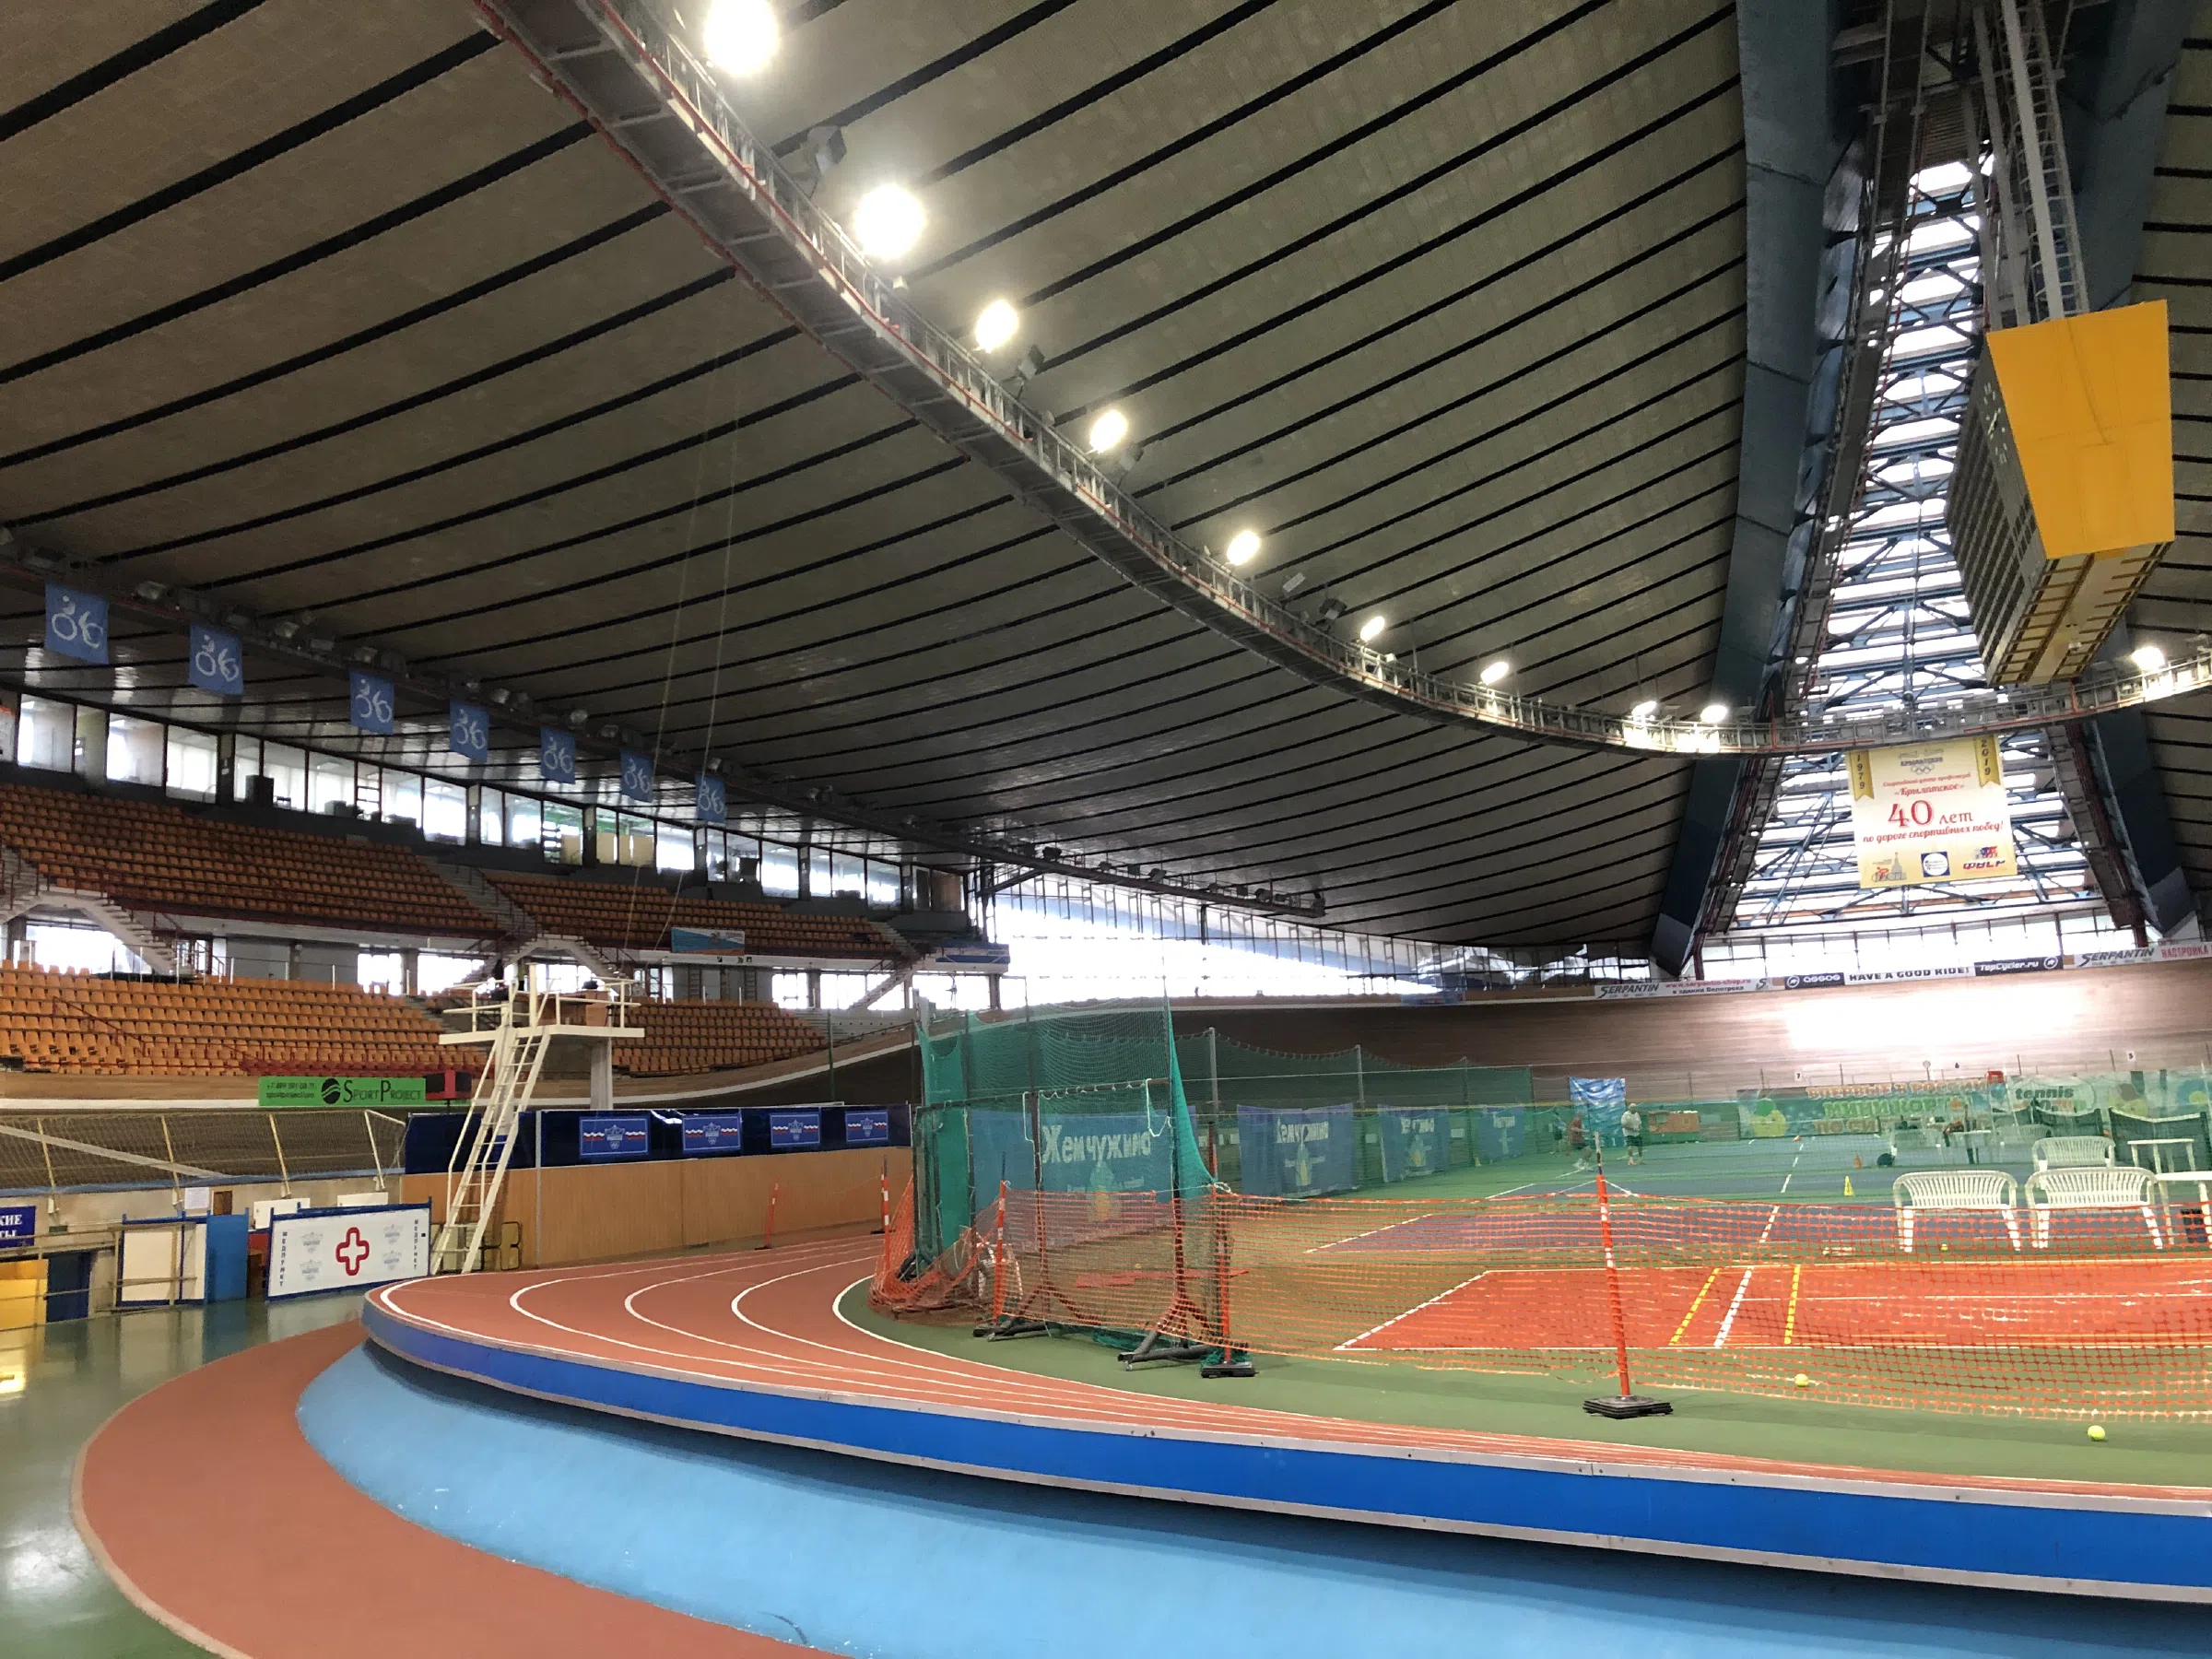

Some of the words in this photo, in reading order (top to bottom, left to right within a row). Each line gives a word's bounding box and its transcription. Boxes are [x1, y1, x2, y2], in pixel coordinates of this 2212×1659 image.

[1856, 754, 1865, 790] 1979
[1888, 800, 1934, 827] 40
[1939, 812, 1972, 825] лет
[1877, 832, 1907, 843] дороге
[1909, 827, 1971, 839] спортивных
[1972, 821, 2004, 832] побед!
[2077, 948, 2155, 967] SERPANTIN
[1849, 973, 1881, 982] HAVE
[1897, 970, 1932, 979] GOOD
[1599, 982, 1659, 998] SERPANTIN
[2016, 1086, 2074, 1100] tennis
[1824, 1100, 1890, 1117] МИНИ
[1041, 1124, 1151, 1165] Жемчужина
